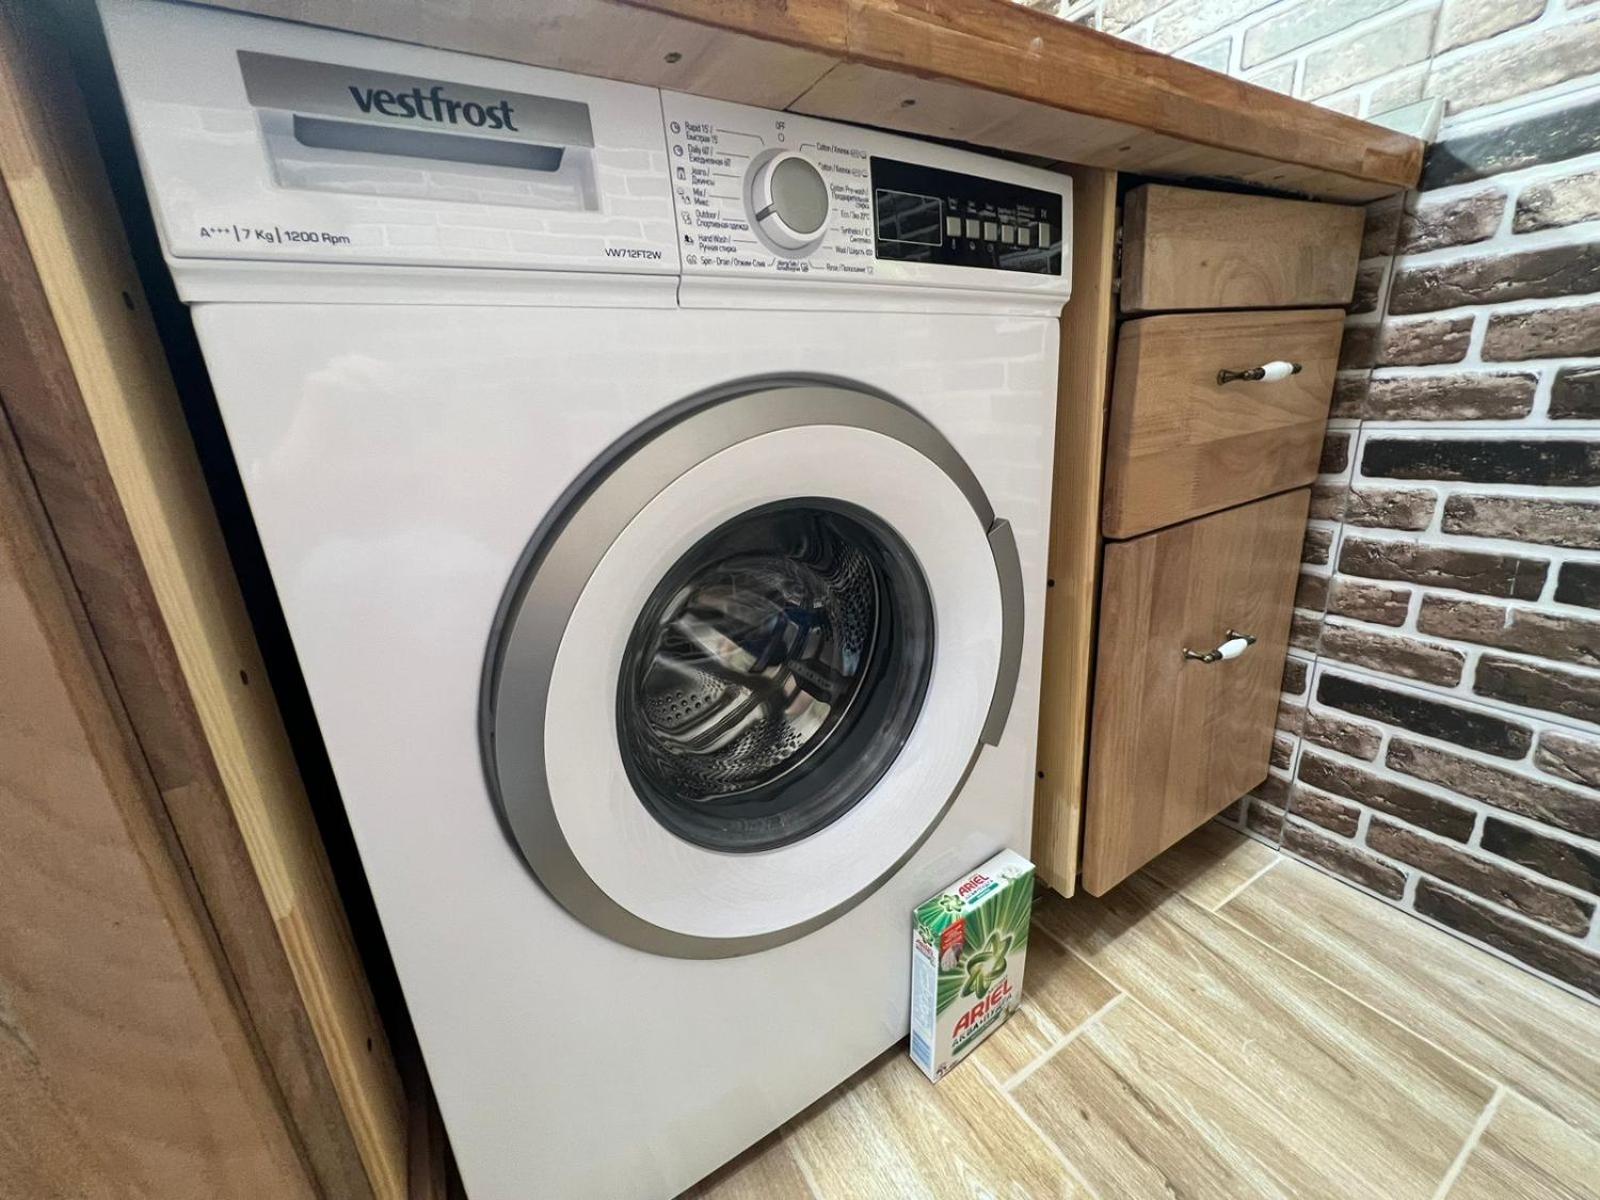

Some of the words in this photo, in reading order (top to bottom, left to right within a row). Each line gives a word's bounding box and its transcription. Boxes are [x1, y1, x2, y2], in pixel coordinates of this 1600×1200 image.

[348, 86, 518, 132] vestfrost
[255, 229, 274, 243] Kg
[284, 231, 319, 242] 1200
[322, 233, 351, 245] Rpm
[605, 247, 662, 259] VW712FT2W
[958, 874, 990, 897] ARIEL
[952, 978, 1013, 1039] ARIEL
